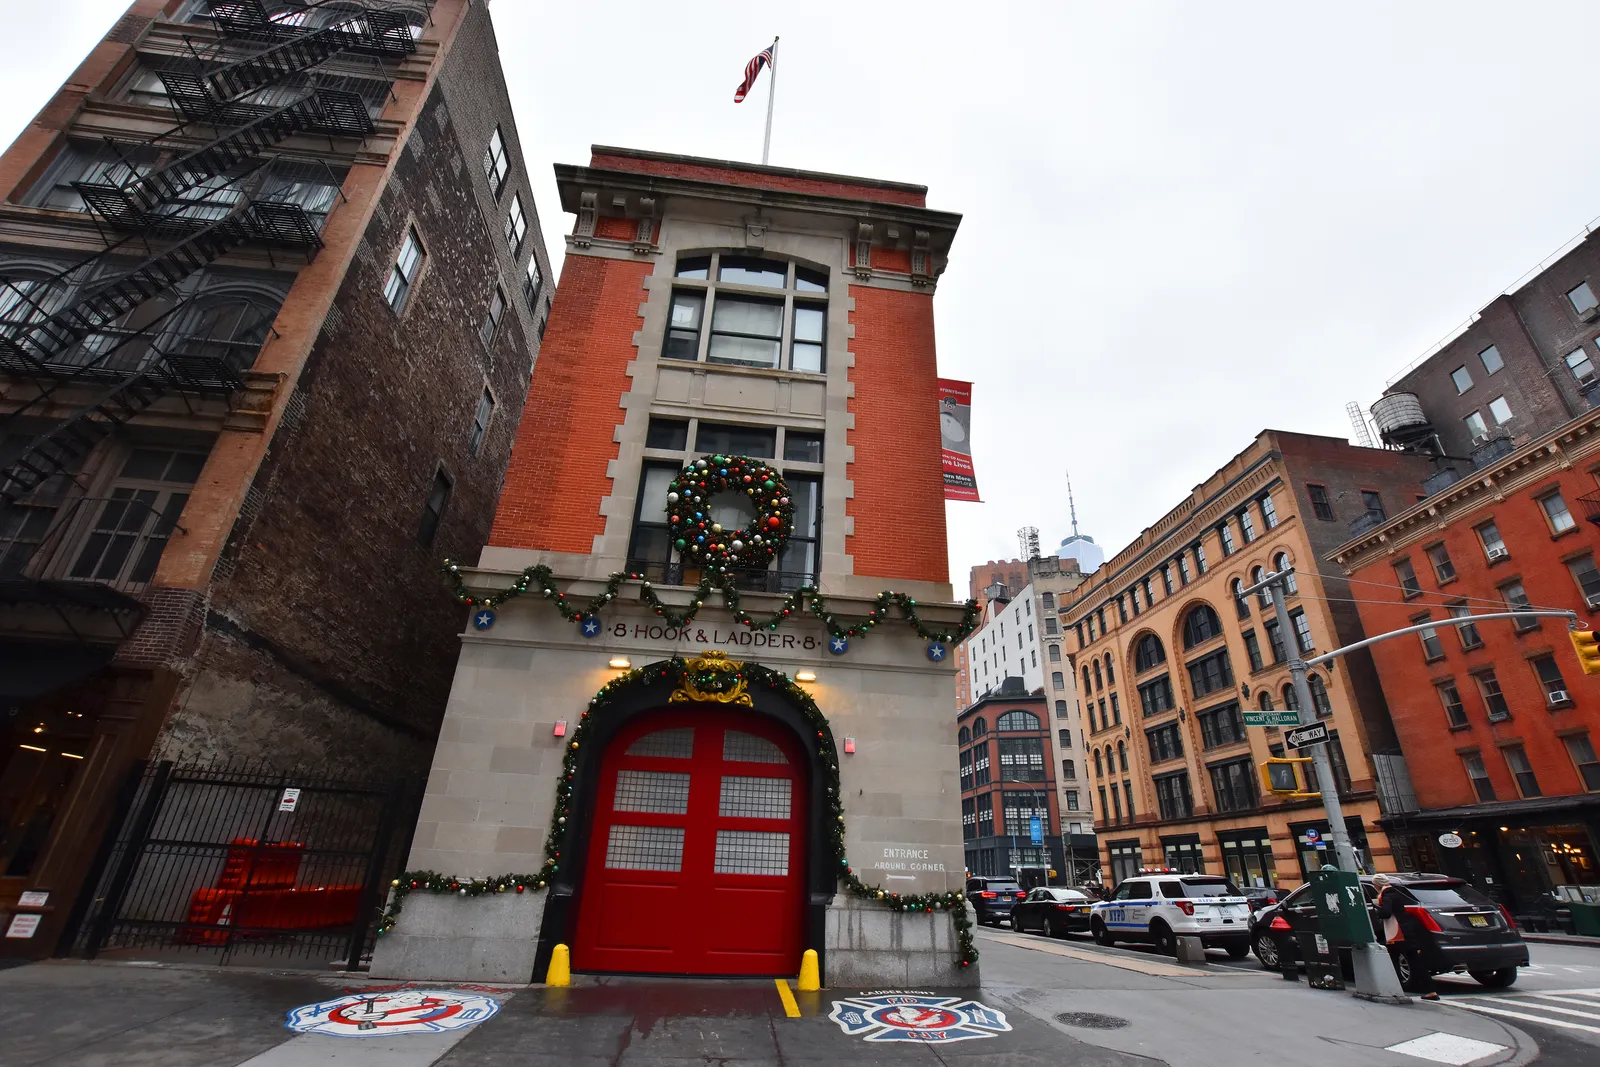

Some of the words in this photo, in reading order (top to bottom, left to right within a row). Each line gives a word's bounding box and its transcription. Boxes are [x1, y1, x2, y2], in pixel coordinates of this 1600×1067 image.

[954, 461, 971, 469] Lives
[614, 623, 627, 637] 8
[634, 624, 691, 642] HOOK
[695, 629, 709, 643] &
[714, 630, 795, 649] LADDER
[803, 636, 816, 650] 8
[1291, 733, 1304, 743] ONE
[1308, 728, 1322, 739] WAY
[883, 848, 929, 859] ENTRANCE
[874, 861, 906, 870] AROUND
[910, 862, 945, 872] CORNER
[1109, 908, 1126, 922] NYPD
